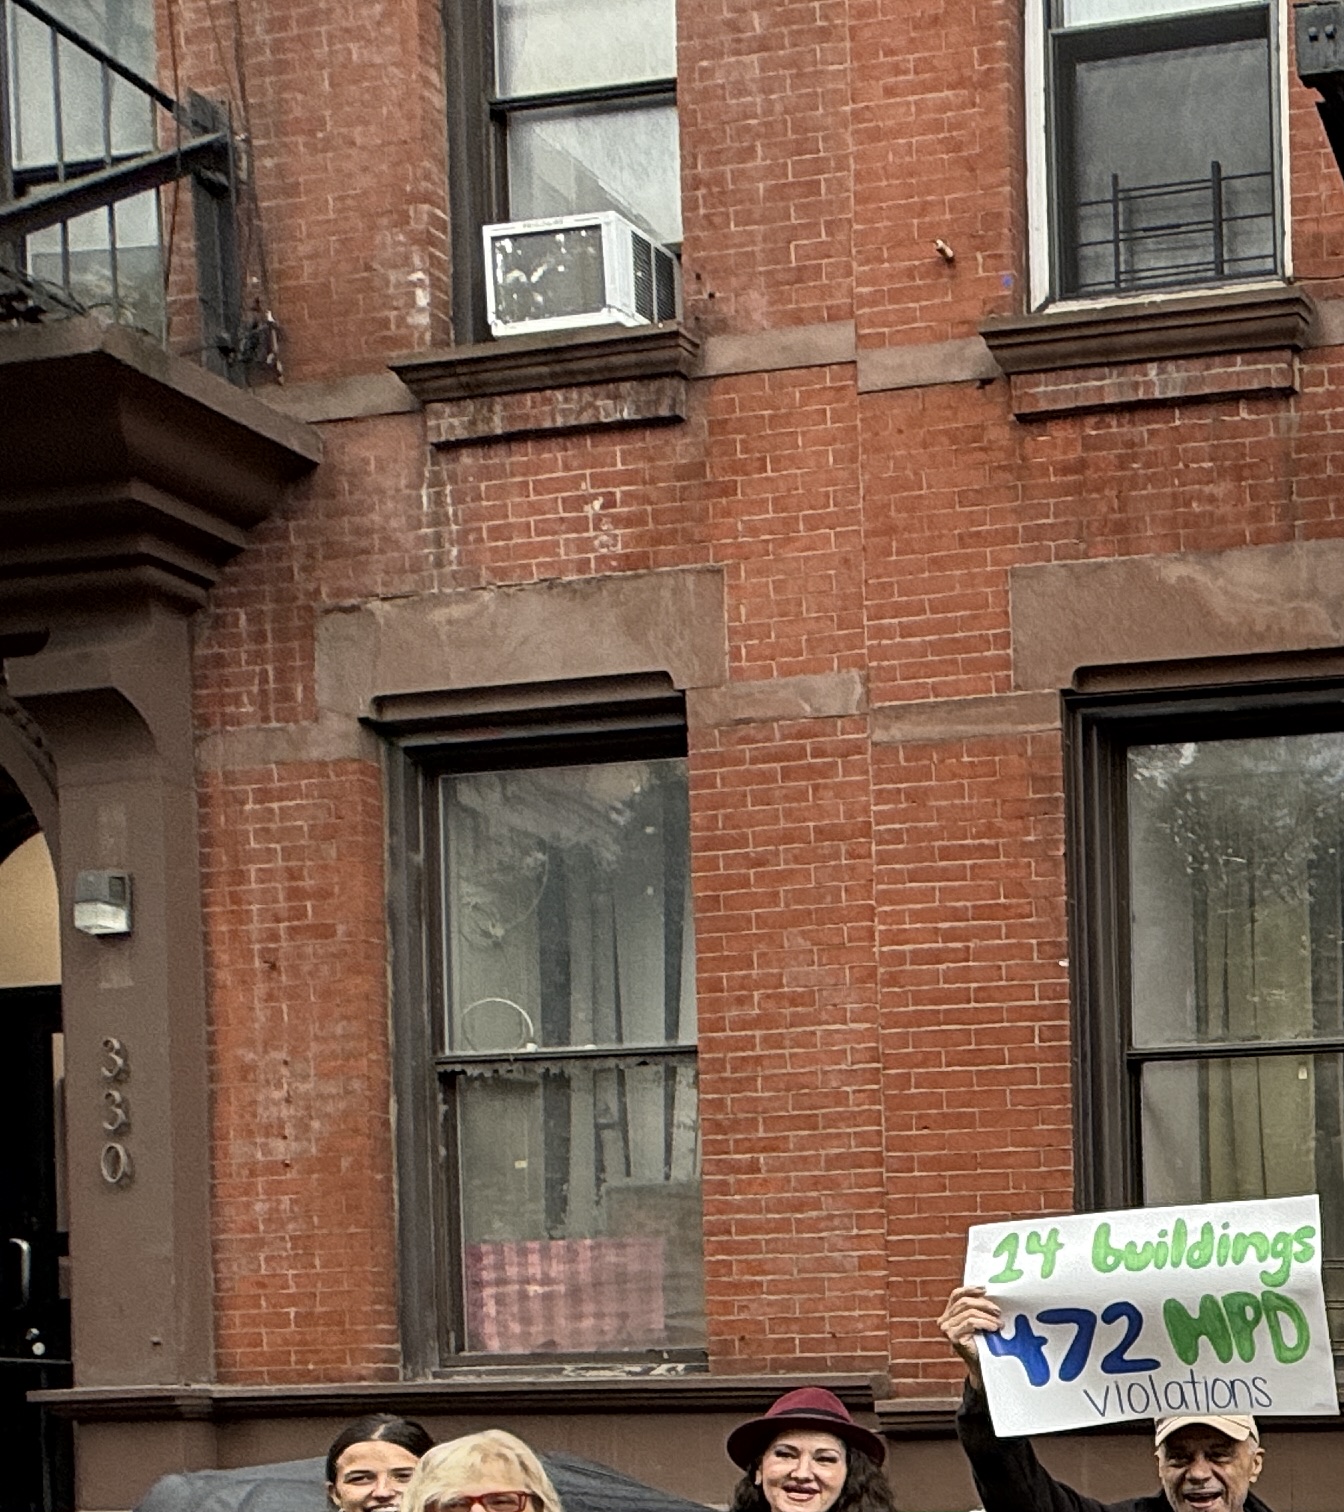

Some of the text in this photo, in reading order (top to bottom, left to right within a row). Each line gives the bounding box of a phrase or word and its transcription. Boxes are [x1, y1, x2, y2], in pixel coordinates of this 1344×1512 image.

[101, 1037, 131, 1184] 330
[988, 1218, 1316, 1287] 14 buildings
[983, 1301, 1162, 1387] 472
[1083, 1368, 1272, 1417] violations
